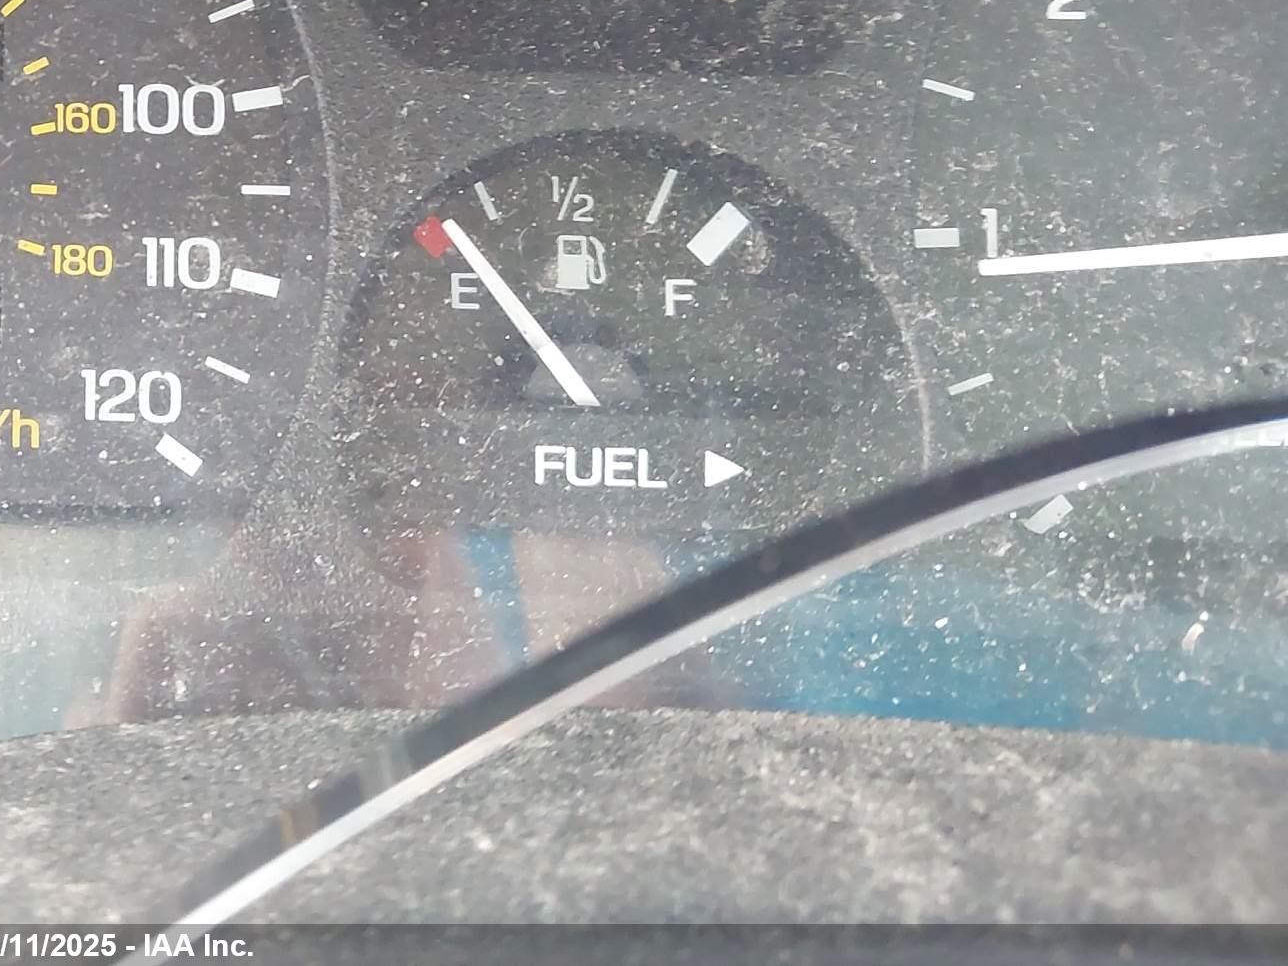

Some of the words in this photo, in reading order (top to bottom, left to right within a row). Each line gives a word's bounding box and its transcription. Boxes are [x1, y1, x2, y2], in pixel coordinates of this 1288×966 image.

[54, 103, 116, 134] 160
[118, 84, 225, 135] 100
[980, 207, 998, 257] 1
[52, 245, 113, 276] 180
[142, 237, 221, 289] 110
[450, 273, 480, 310] E
[664, 278, 697, 317] F
[81, 369, 182, 423] 120
[534, 445, 668, 488] FUEL
